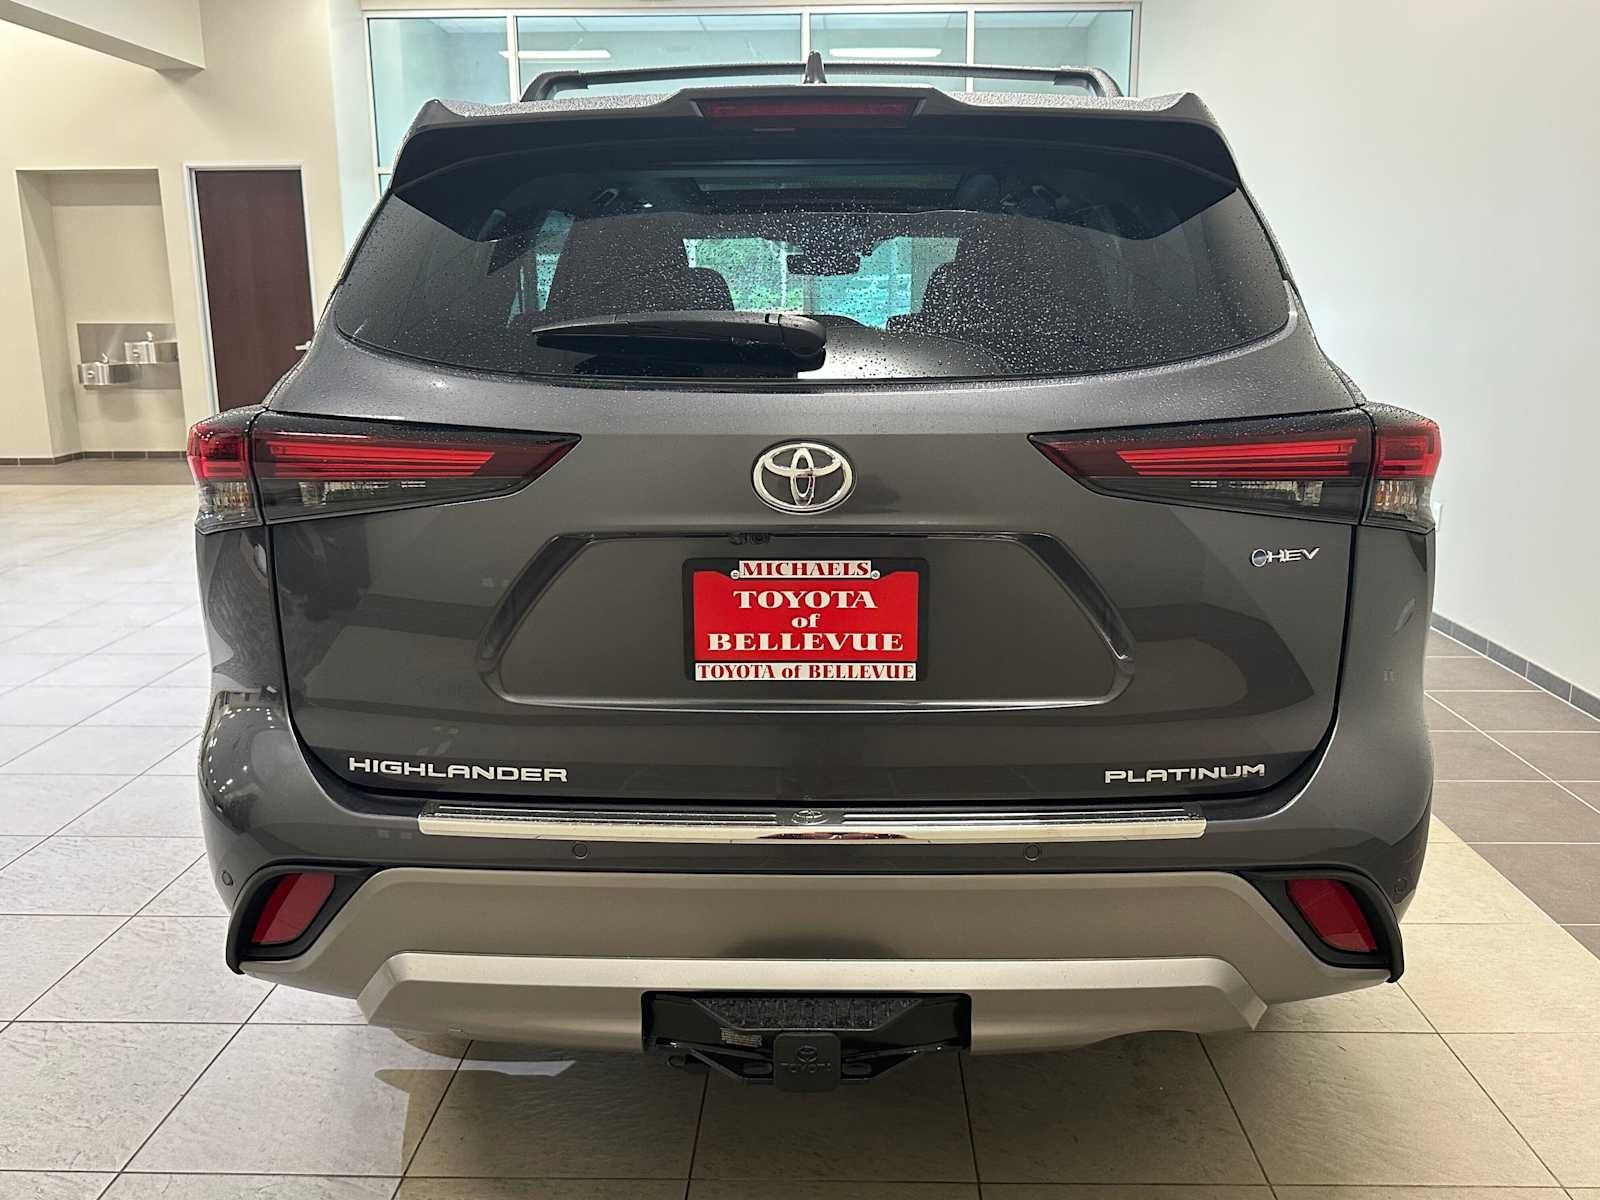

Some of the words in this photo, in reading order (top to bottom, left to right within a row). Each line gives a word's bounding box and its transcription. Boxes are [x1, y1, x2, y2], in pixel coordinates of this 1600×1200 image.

[742, 562, 870, 576] MICHAELS
[733, 590, 878, 609] TOYOTA
[791, 613, 821, 629] of
[706, 633, 904, 651] BELLEVUE
[697, 664, 776, 679] TOYOTA
[781, 664, 803, 679] of
[808, 664, 915, 680] BELLEVUE
[349, 757, 568, 783] HIGHLANDER
[1104, 763, 1265, 784] PLATINUM
